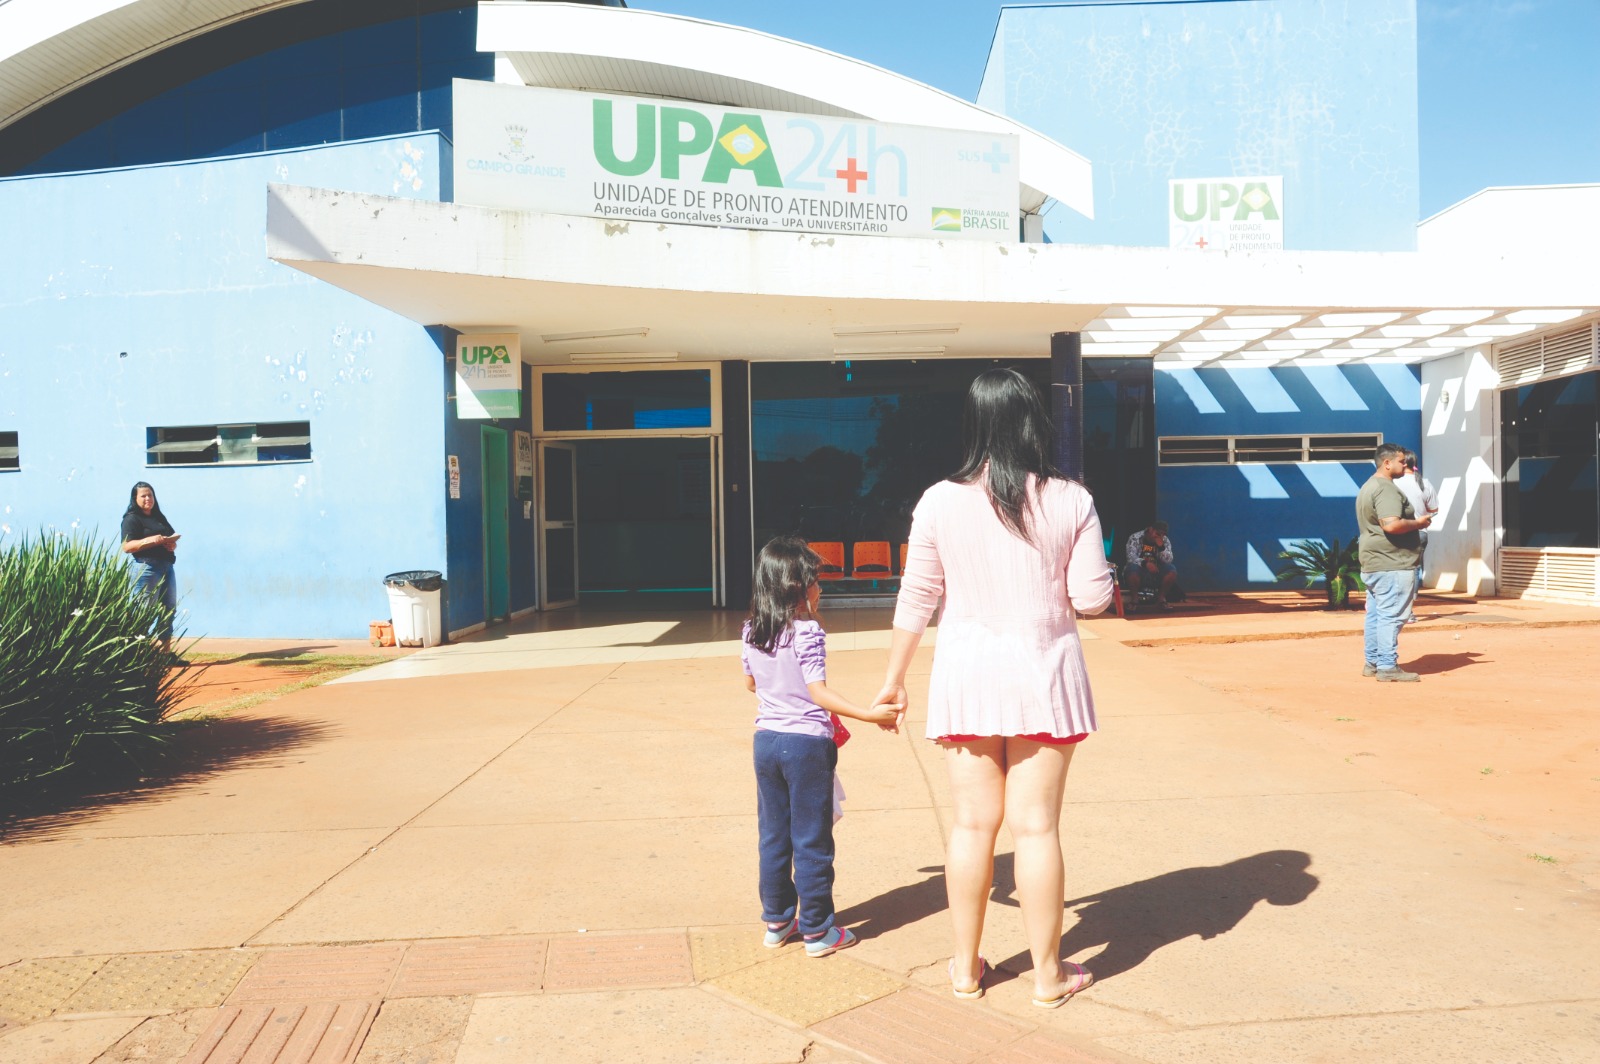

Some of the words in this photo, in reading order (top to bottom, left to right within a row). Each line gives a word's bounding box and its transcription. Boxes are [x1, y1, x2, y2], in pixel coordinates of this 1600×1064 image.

[592, 98, 784, 189] UPA
[784, 117, 908, 198] 24h
[957, 150, 981, 162] SUS
[466, 158, 513, 173] CAMPO
[515, 163, 567, 178] GRANDE
[593, 181, 677, 206] UNIDADE
[684, 189, 706, 208] DE
[713, 191, 783, 214] PRONTO
[788, 198, 908, 222] ATENDIMENTO
[1173, 182, 1280, 222] UPA
[594, 202, 657, 217] Aparecida
[661, 208, 722, 223] Gonçalves
[726, 213, 769, 226] Saraiva
[782, 217, 804, 228] UPA
[807, 219, 888, 233] UNIVERSITÁRIO
[963, 207, 985, 217] PÁTRIA
[986, 209, 1009, 218] AMADA
[963, 216, 1009, 230] BRASIL
[1229, 223, 1262, 231] UNIDADE
[1229, 233, 1239, 241] DE
[1241, 232, 1271, 241] PRONTO
[461, 345, 511, 365] UPA
[461, 365, 486, 379] 24h
